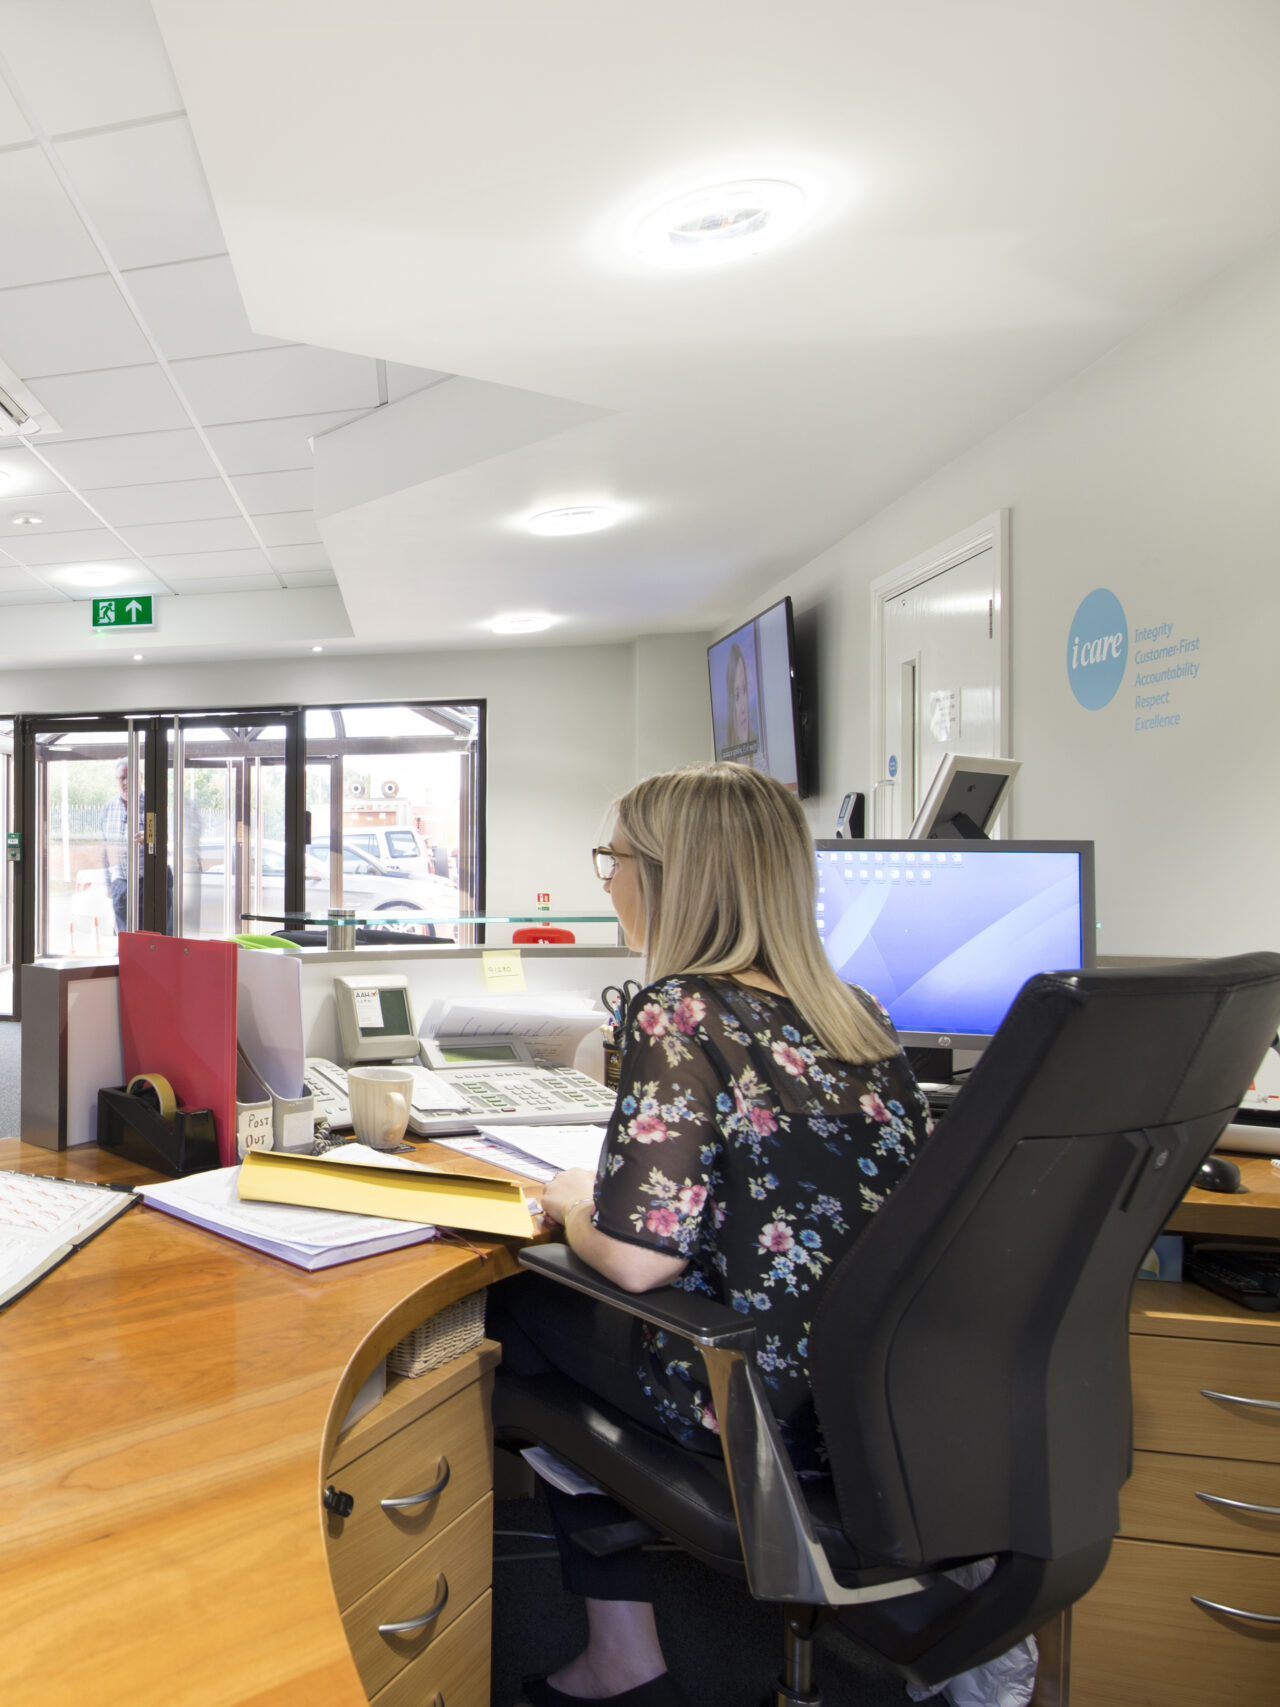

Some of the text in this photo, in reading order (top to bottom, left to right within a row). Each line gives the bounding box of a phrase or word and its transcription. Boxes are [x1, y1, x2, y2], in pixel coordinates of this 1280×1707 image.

[1134, 622, 1174, 643] Integrity
[1134, 637, 1201, 665] Customer-First
[1134, 662, 1201, 687] Accountability
[1134, 691, 1171, 710] Respect
[1134, 712, 1181, 731] Excellence
